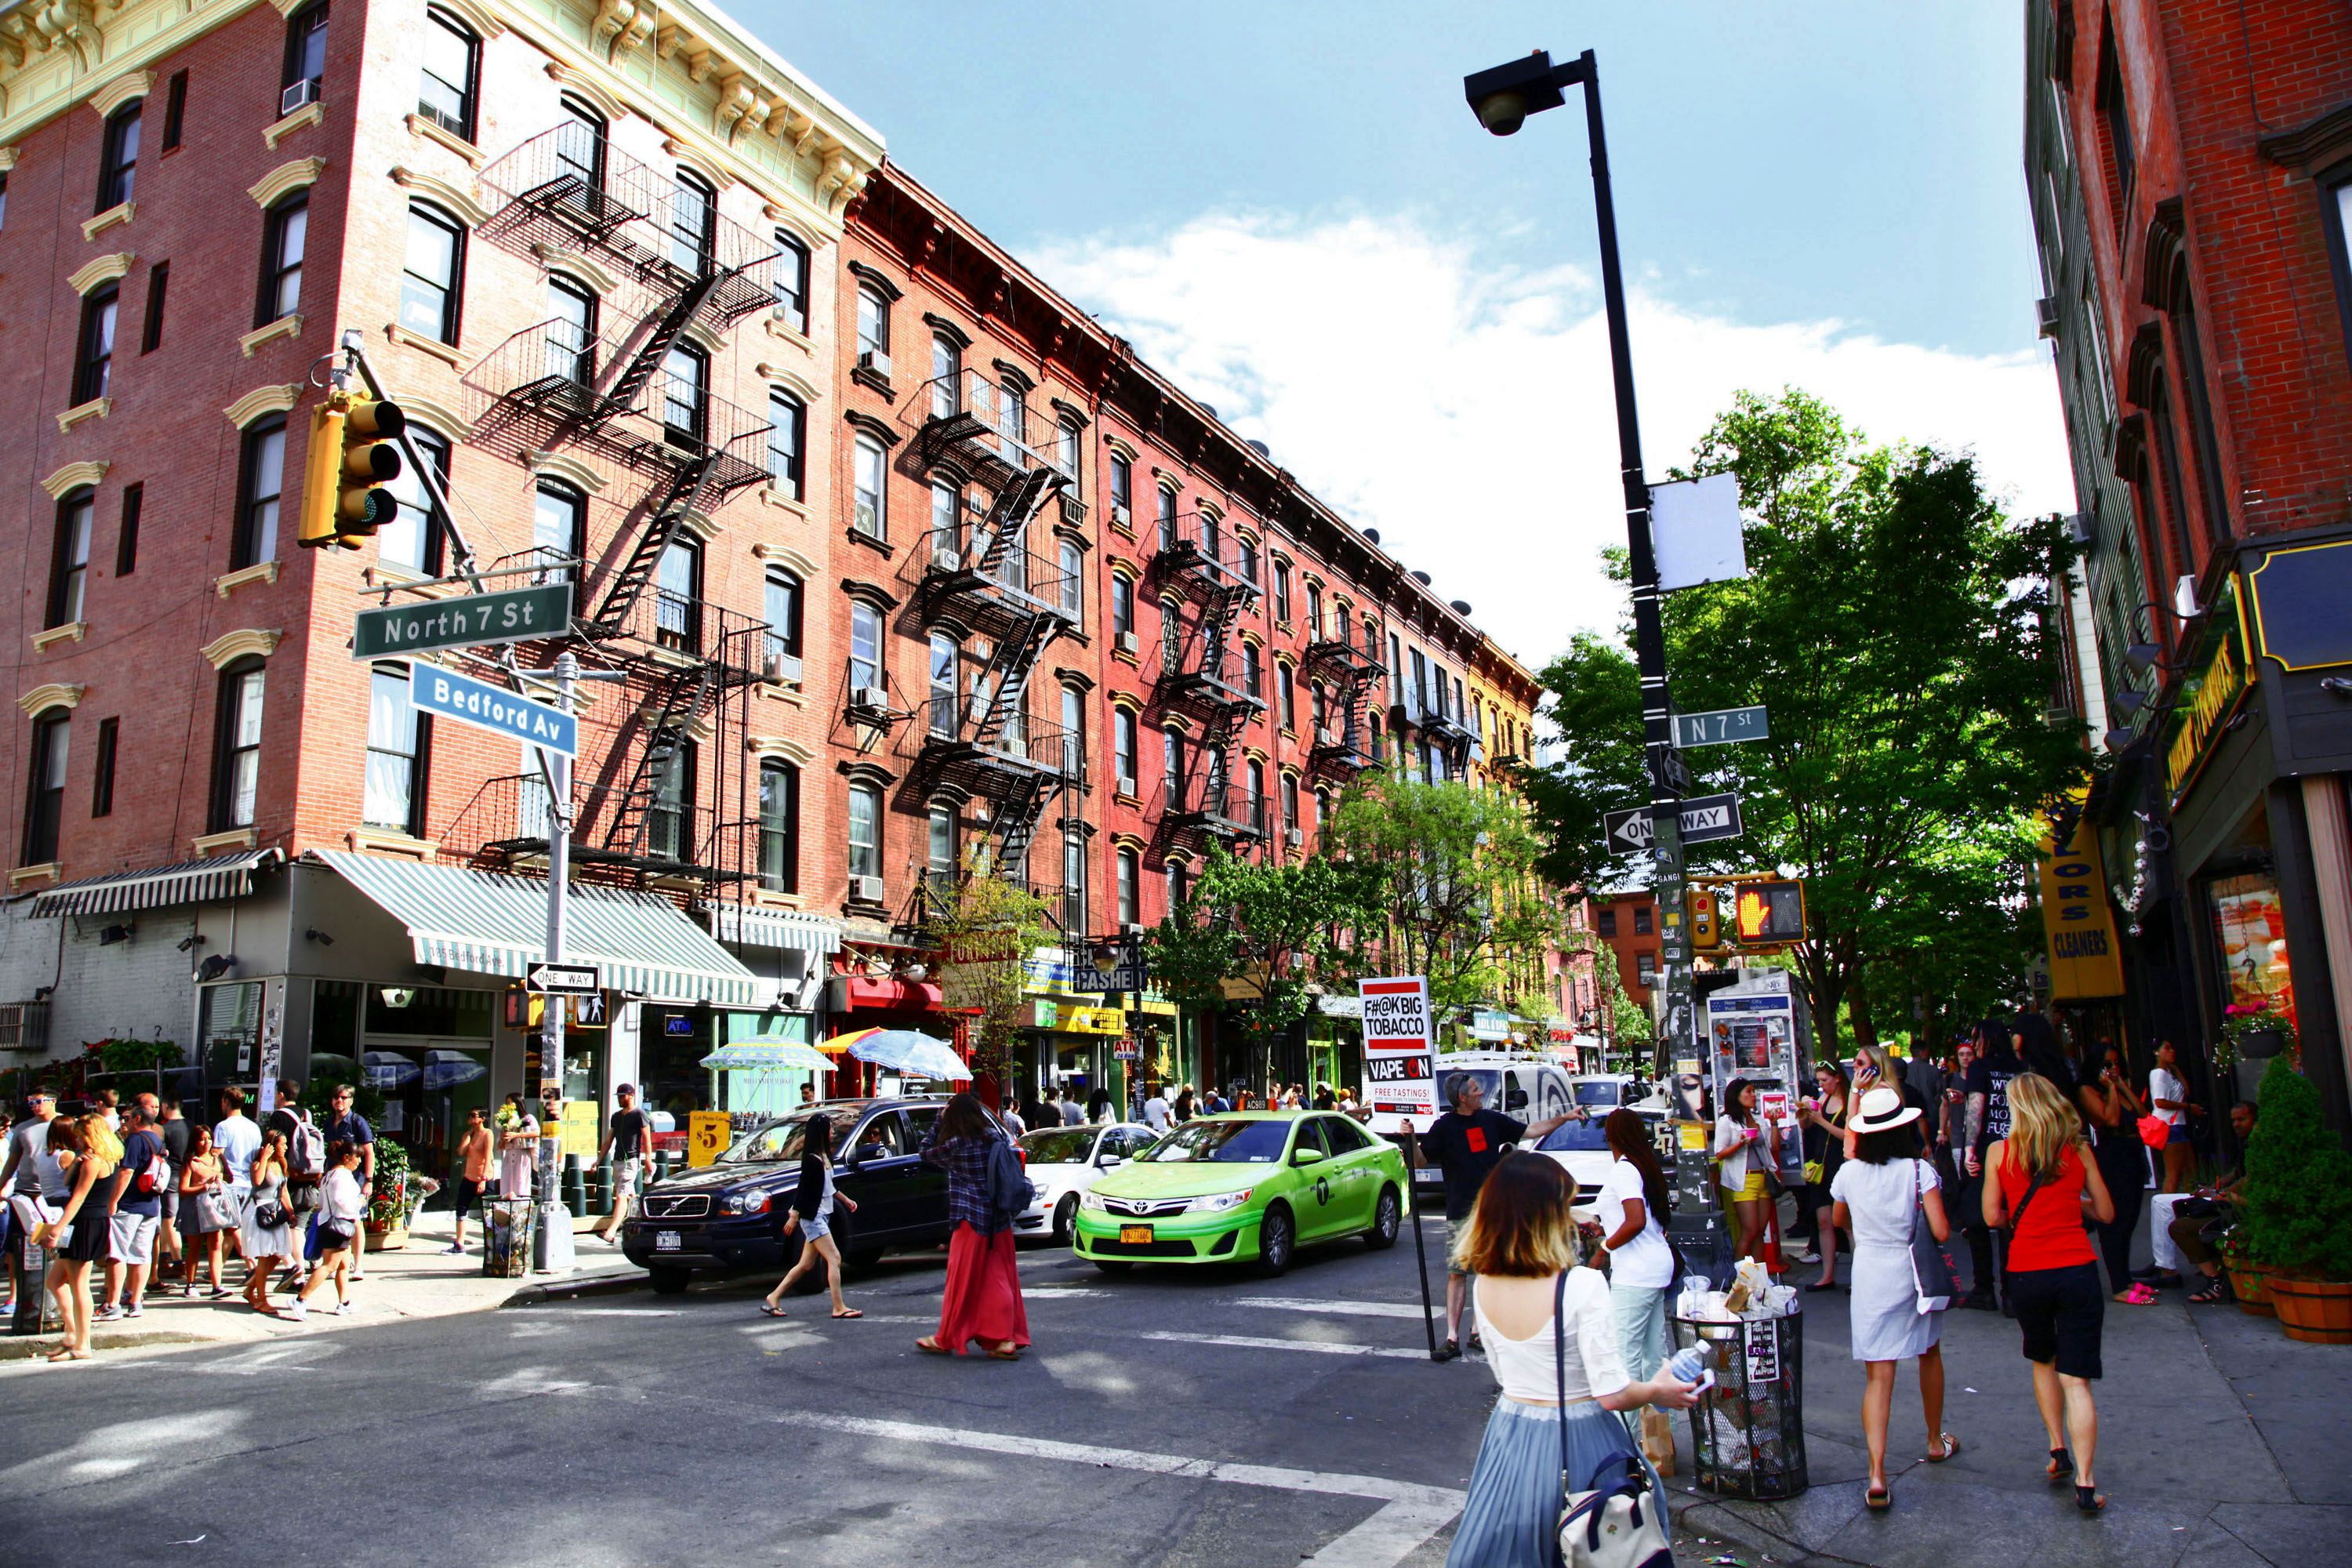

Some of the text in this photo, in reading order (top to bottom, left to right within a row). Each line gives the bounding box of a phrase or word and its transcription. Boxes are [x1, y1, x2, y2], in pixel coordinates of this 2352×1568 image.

[384, 600, 535, 644] North 7 St
[434, 678, 560, 741] Bedford Av
[1692, 717, 1707, 742] N
[1716, 715, 1728, 739] 7
[1627, 808, 1719, 839] ON WAY
[2054, 928, 2108, 960] CLEANERS
[430, 946, 505, 968] 185 Bedford Ave.
[538, 971, 590, 985] ONE WAY
[1091, 1013, 1118, 1022] WESTERN
[1364, 996, 1422, 1018] F#@K BIG
[668, 1018, 691, 1031] ATM
[1366, 1017, 1425, 1036] TOBACCO
[1370, 1058, 1429, 1080] VAPE ON
[1374, 1087, 1430, 1098] FREE TASTINGS!
[1247, 1100, 1265, 1109] AC989
[696, 1123, 717, 1149] $5
